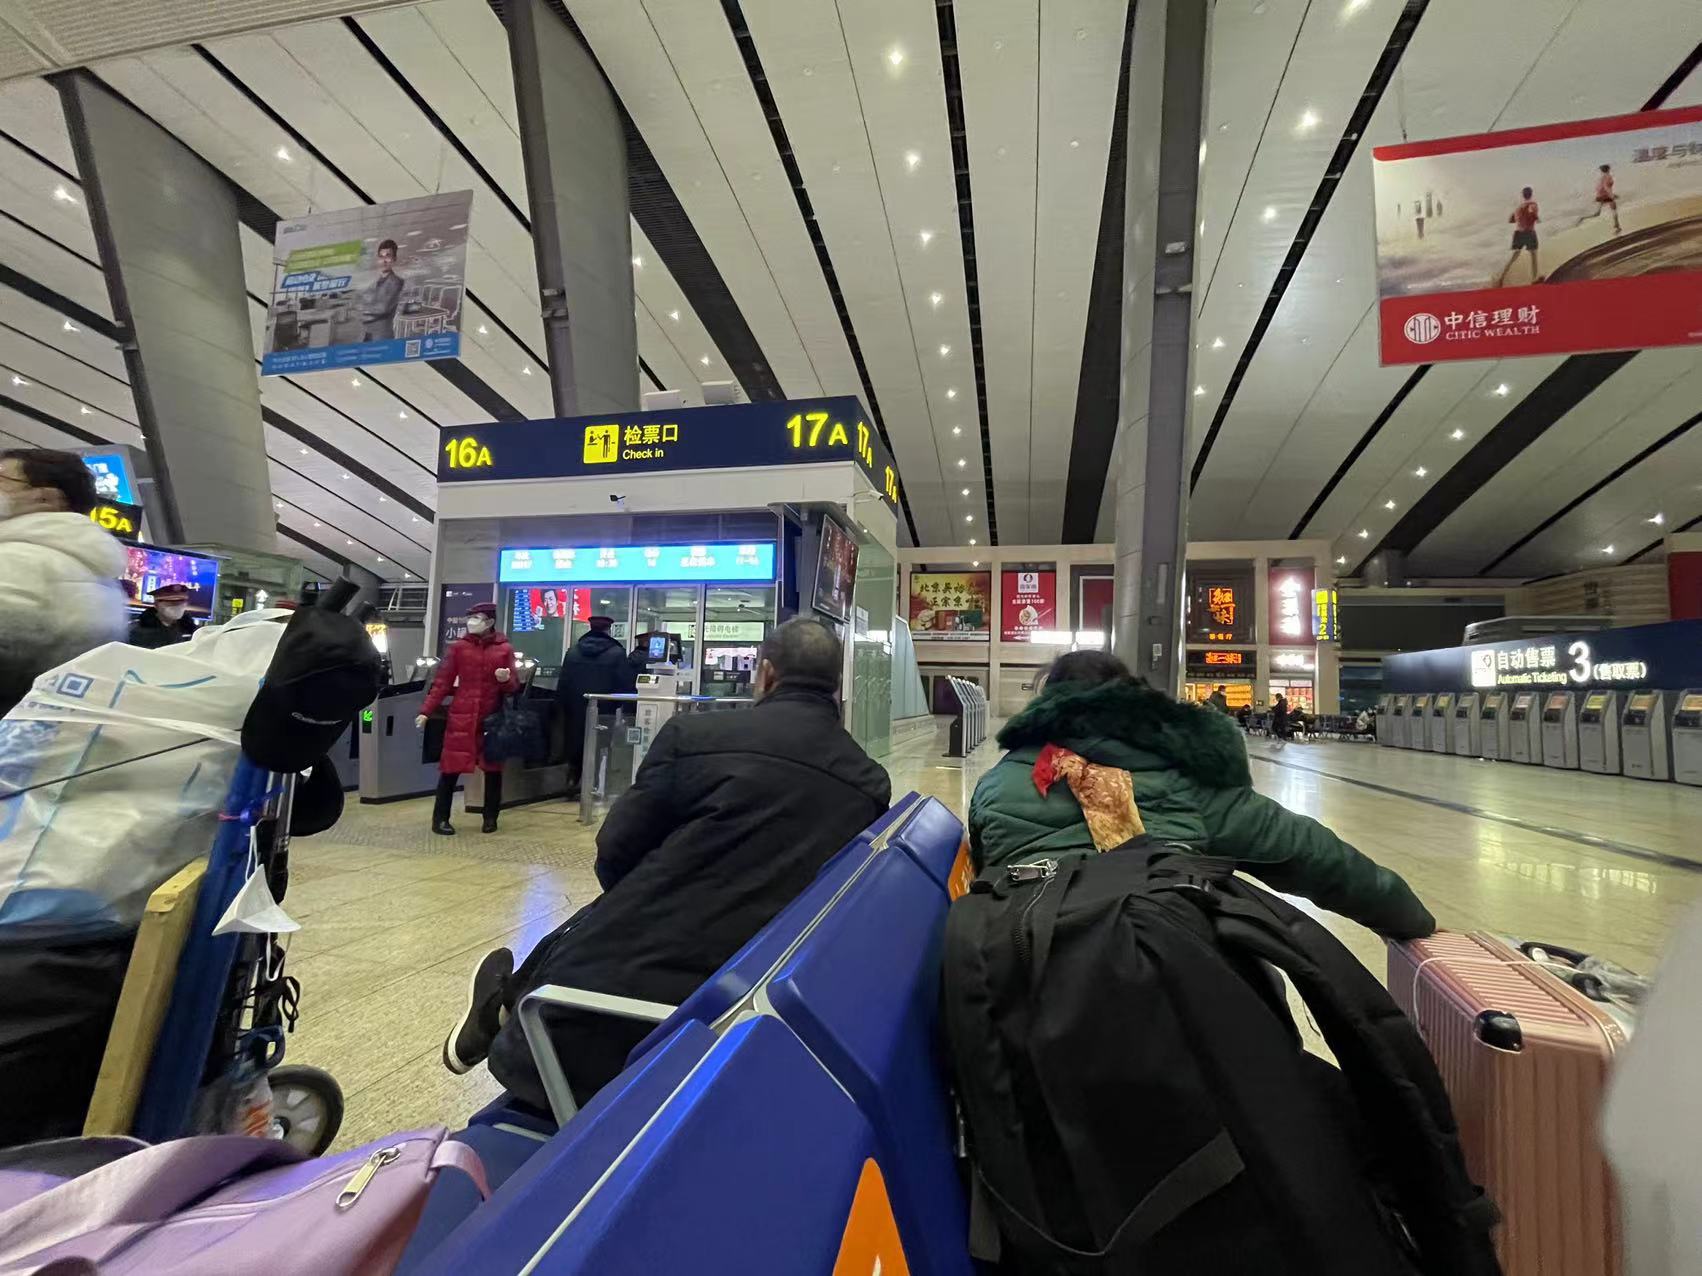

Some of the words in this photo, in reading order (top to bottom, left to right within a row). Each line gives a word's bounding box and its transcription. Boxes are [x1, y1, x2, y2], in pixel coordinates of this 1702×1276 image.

[1444, 305, 1541, 330] 中信理财
[1445, 330, 1481, 341] CITIC
[1484, 325, 1541, 338] WEALTH
[623, 424, 679, 446] 检票口
[787, 412, 849, 448] 17A
[445, 437, 492, 468] 16A
[622, 448, 653, 460] Check
[654, 447, 664, 458] in
[857, 421, 873, 469] 17A
[885, 465, 897, 504] 17A
[1497, 645, 1556, 670] 自动售票
[1568, 641, 1591, 682] 3
[1497, 671, 1532, 685] Automatic
[1531, 671, 1568, 685] Ticketing
